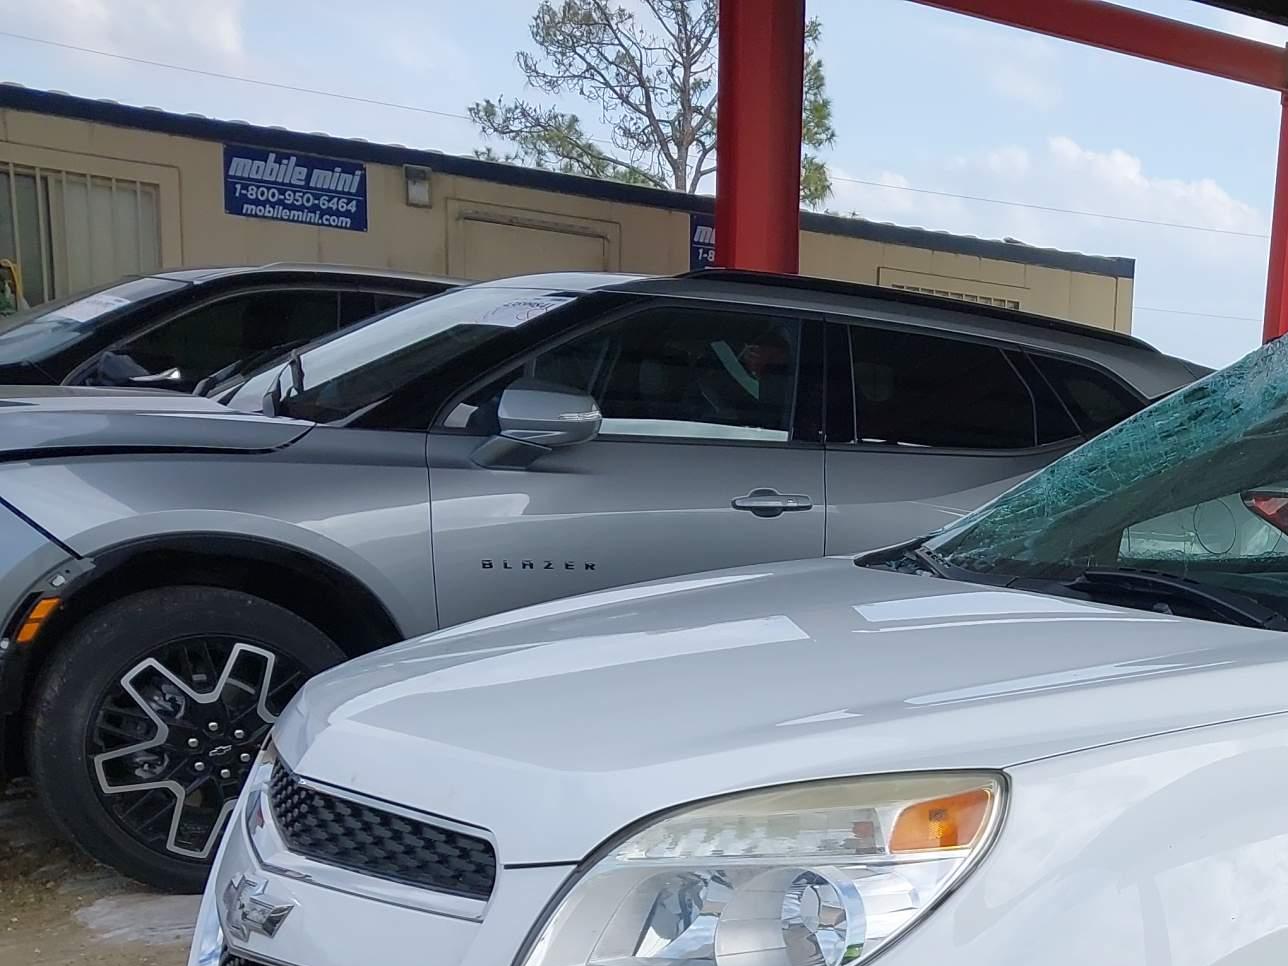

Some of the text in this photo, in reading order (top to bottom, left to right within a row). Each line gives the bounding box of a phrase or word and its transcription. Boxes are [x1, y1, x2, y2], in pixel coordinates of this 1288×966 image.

[228, 152, 362, 193] mobile mini
[234, 183, 357, 213] 1-800-950-6464
[242, 202, 352, 229] mobilemini.com
[481, 559, 596, 571] BLAZER
